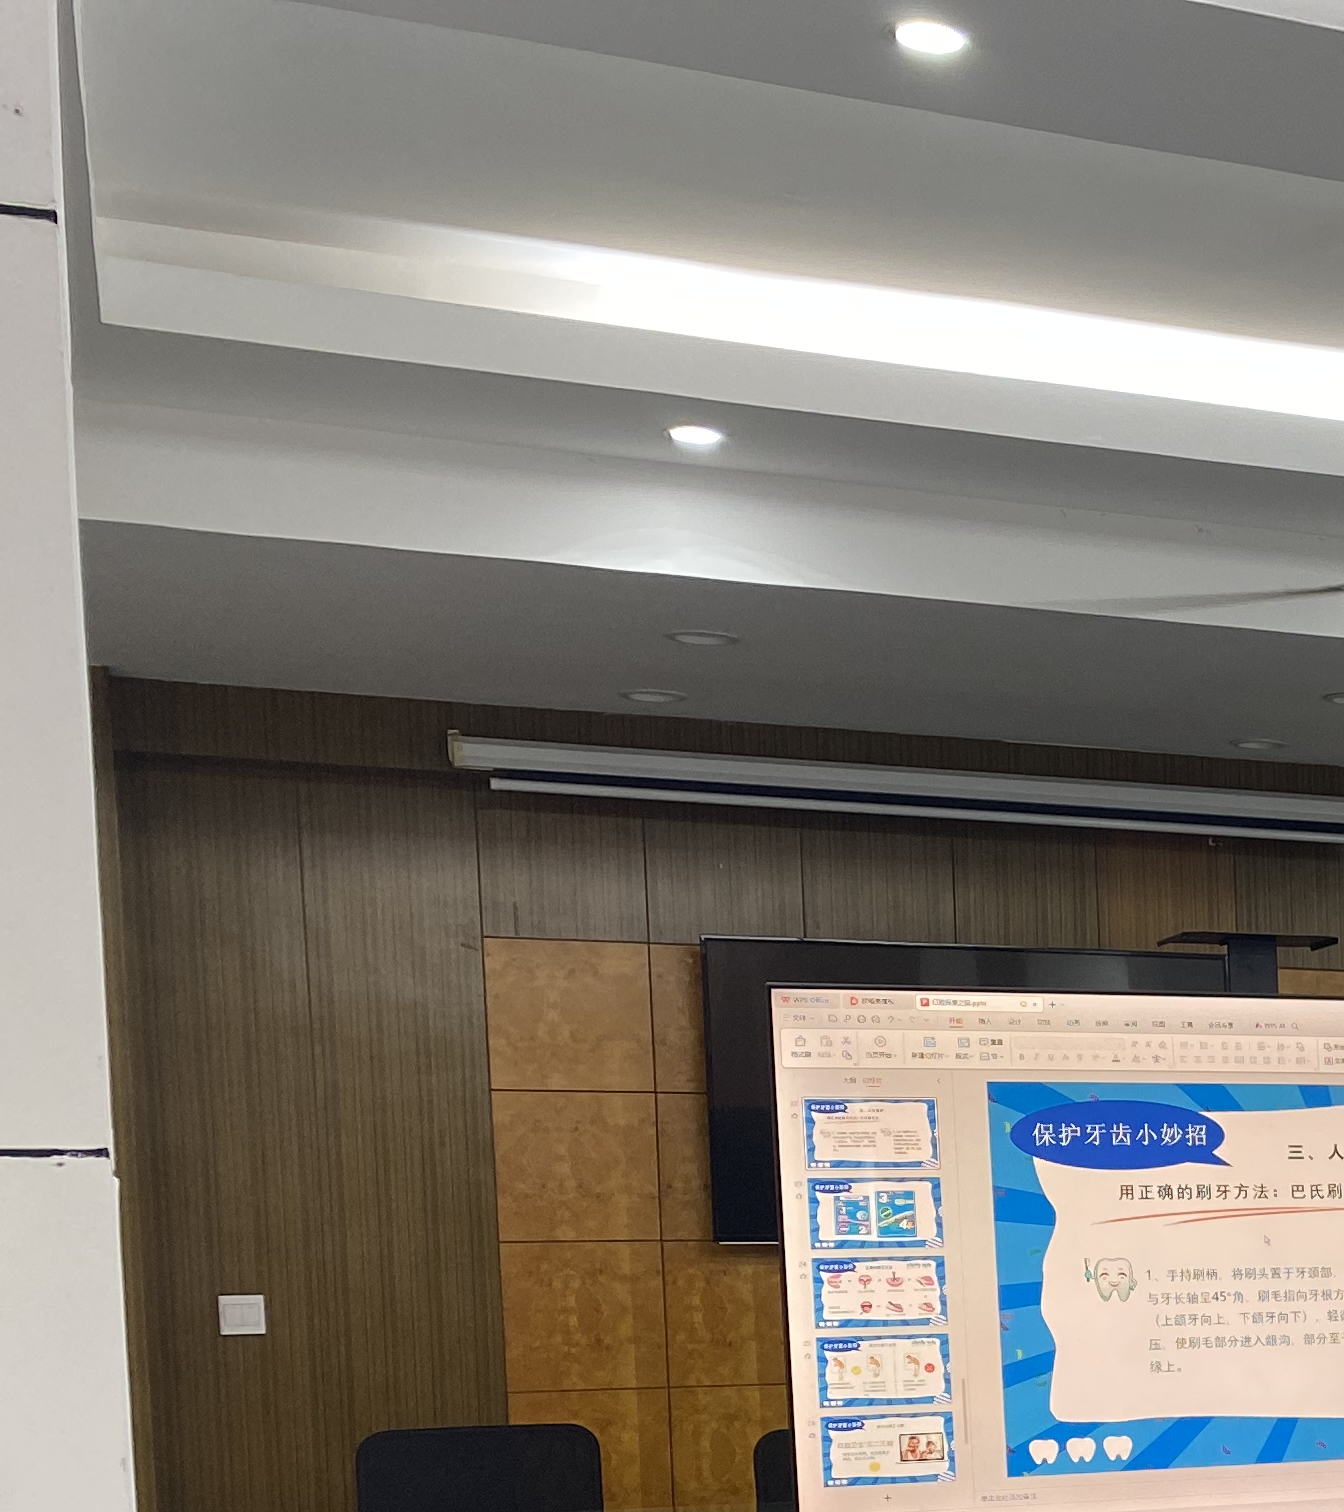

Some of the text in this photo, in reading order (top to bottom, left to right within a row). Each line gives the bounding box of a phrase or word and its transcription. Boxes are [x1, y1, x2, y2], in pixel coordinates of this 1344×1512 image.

[1032, 1122, 1208, 1147] 保护牙齿小妙招
